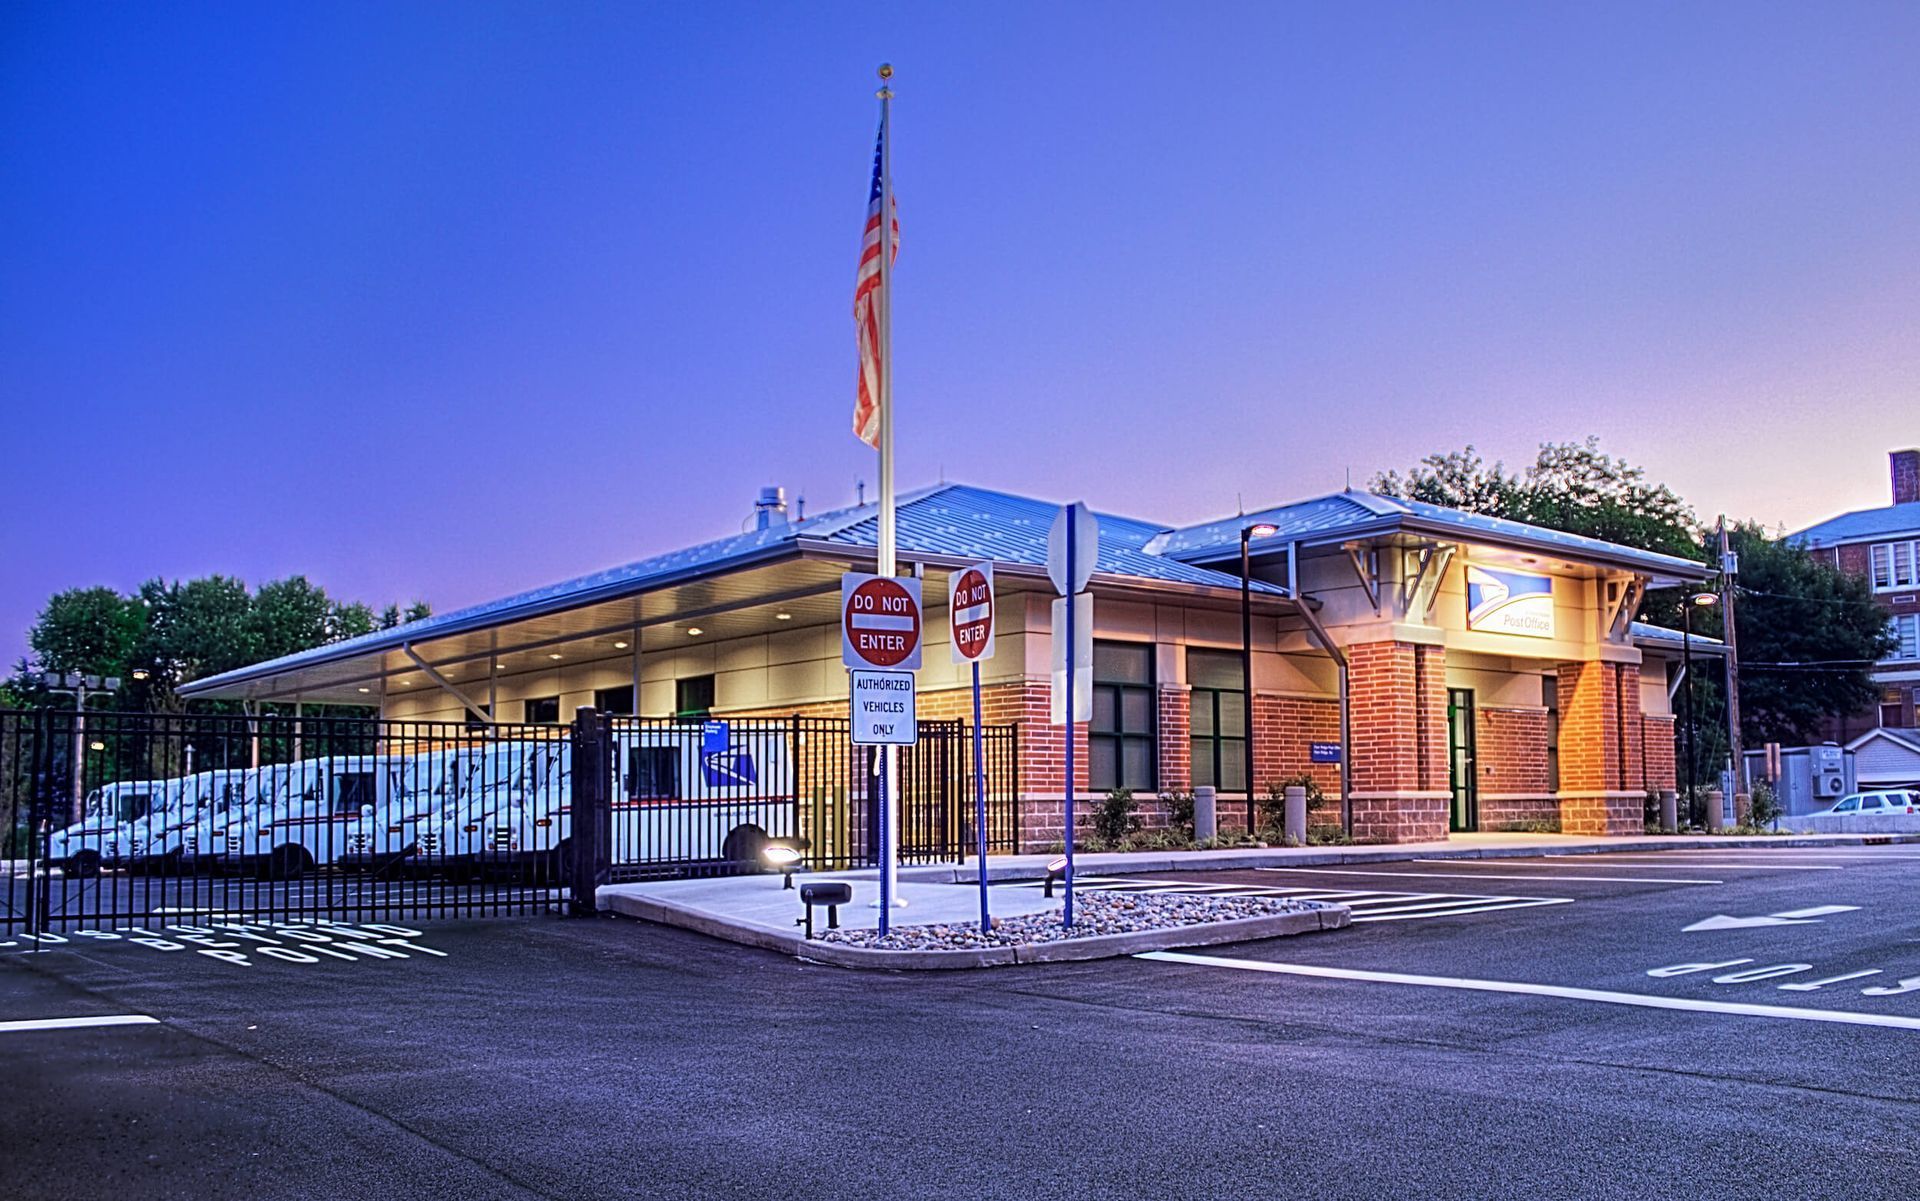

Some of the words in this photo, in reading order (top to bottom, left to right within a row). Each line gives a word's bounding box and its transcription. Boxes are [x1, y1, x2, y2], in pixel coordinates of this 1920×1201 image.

[854, 594, 874, 610] DO
[882, 597, 909, 612] NOT
[956, 592, 968, 607] DO
[971, 584, 987, 600] NOT
[860, 634, 905, 651] ENTER
[959, 625, 985, 645] ENTER
[856, 678, 911, 692] AUTHORIZED
[863, 701, 905, 714] VEHICLES
[872, 724, 895, 736] ONLY
[128, 923, 423, 951] BEYOND
[197, 938, 448, 966] POINT
